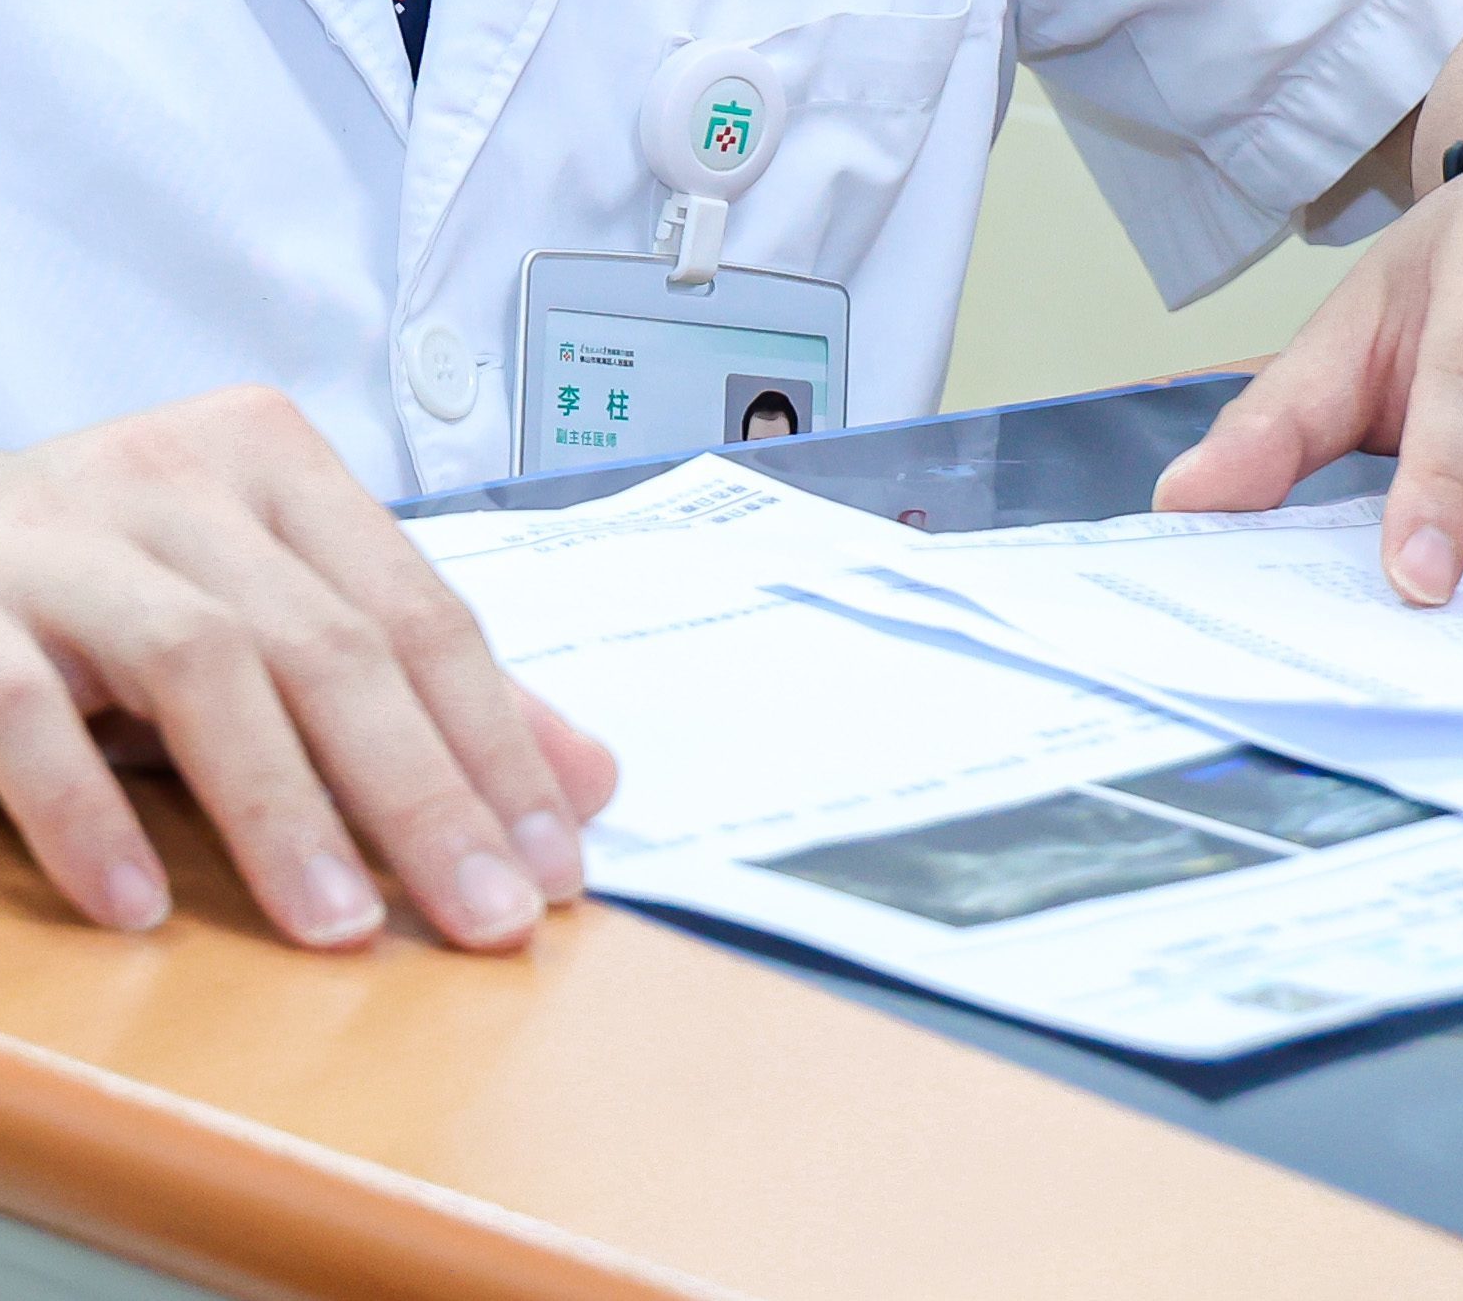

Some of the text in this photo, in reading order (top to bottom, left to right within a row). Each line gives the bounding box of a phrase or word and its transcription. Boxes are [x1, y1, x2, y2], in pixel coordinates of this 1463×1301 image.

[555, 427, 618, 448] 副主任医师
